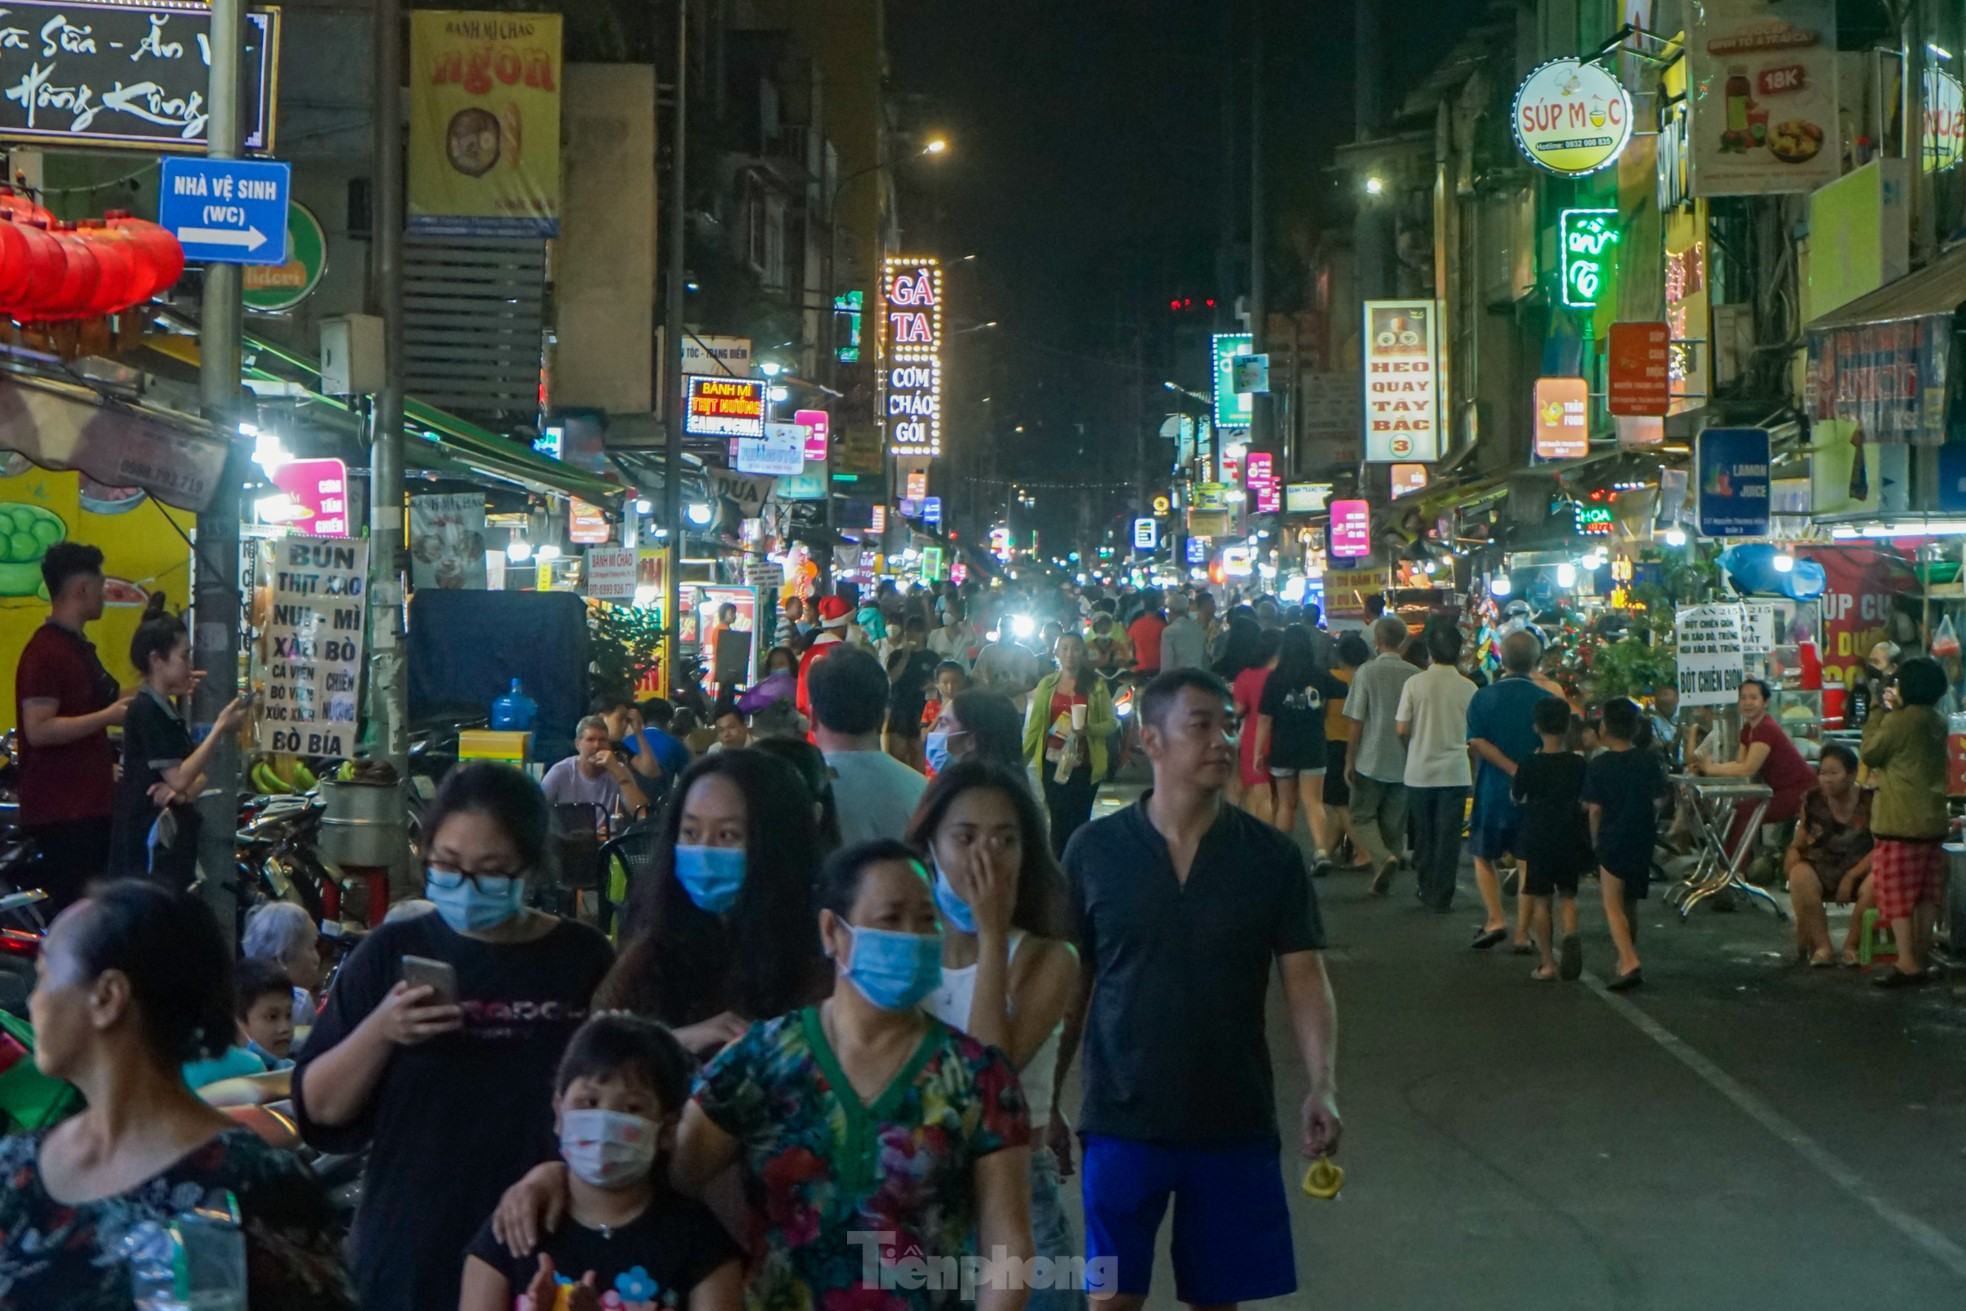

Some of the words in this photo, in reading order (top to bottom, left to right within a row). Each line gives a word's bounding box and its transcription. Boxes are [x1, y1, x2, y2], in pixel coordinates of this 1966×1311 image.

[1765, 69, 1798, 90] 18K
[1522, 96, 1563, 133] SÚP
[174, 173, 208, 197] NHÀ
[212, 175, 234, 202] VỆ
[238, 180, 277, 200] SINH
[203, 205, 246, 227] (WC)
[890, 268, 935, 305] GÀ
[890, 312, 932, 342] TA
[686, 344, 699, 358] TÓC
[892, 365, 931, 388] CƠM
[1371, 361, 1430, 373] HEO
[702, 380, 736, 396] BÁNH
[737, 383, 752, 397] MÌ
[1371, 380, 1429, 393] QUAY
[691, 396, 719, 415] THỊT
[719, 396, 762, 415] NƯỚNG
[889, 389, 933, 416] CHÁO
[1372, 398, 1430, 412] TÂY
[895, 415, 926, 442] GỎI
[1372, 415, 1430, 432] BẮC
[1392, 440, 1409, 453] 3
[1580, 508, 1611, 522] HOA
[289, 540, 355, 570] BÚN
[592, 551, 608, 568] BÁNH
[278, 572, 320, 597] THỊT
[334, 603, 361, 631] MÌ
[325, 636, 357, 662] BÒ
[272, 661, 287, 679] CÁ
[270, 684, 286, 700] BÒ
[1680, 665, 1696, 699] BỘT
[1698, 665, 1723, 693] CHIÊN
[265, 704, 288, 720] XÚC
[271, 726, 302, 752] BÒ
[307, 729, 342, 756] BÍA
